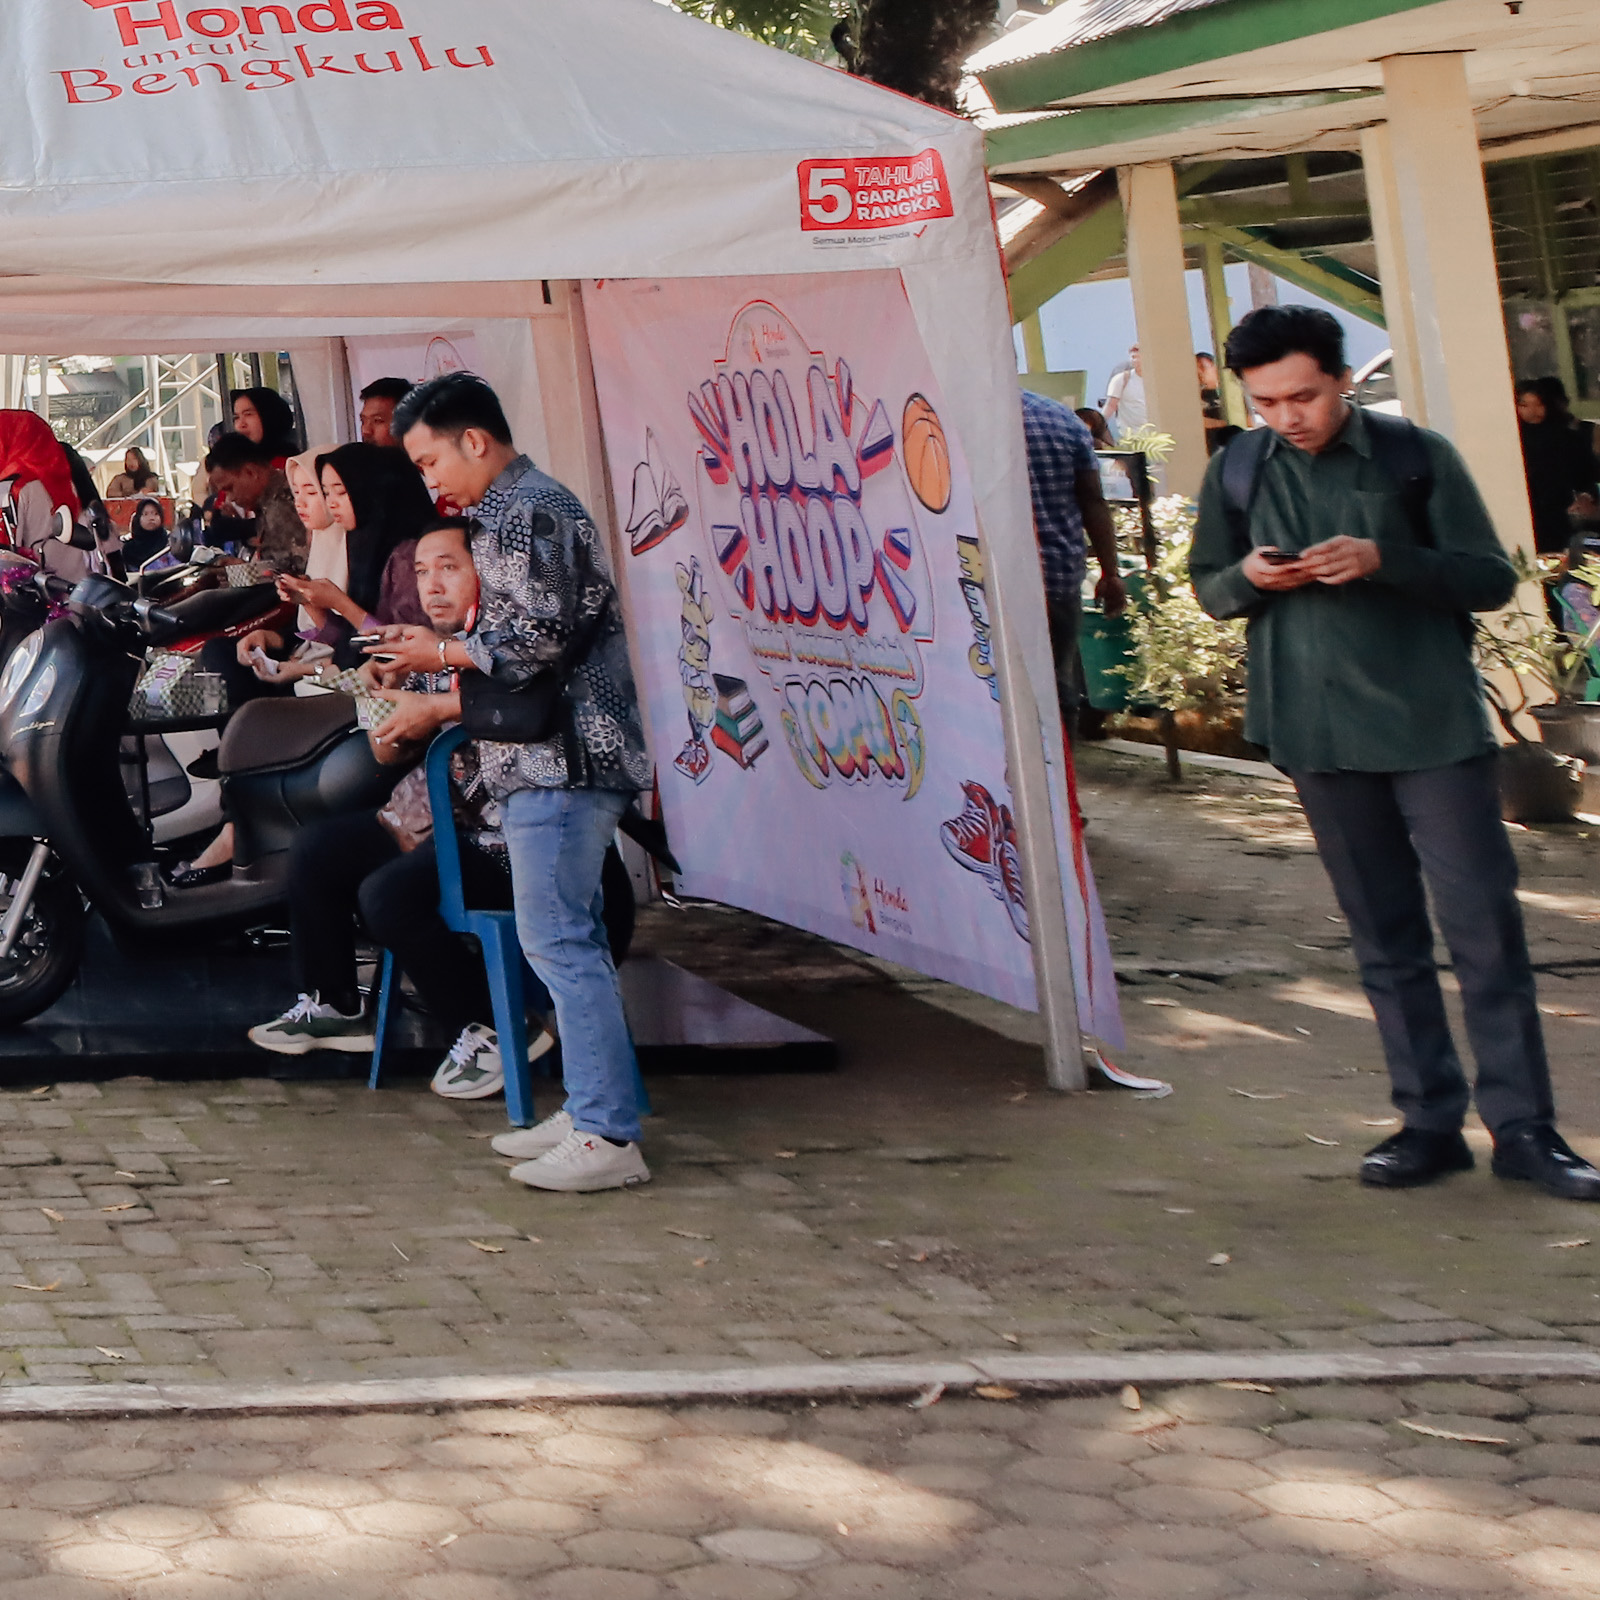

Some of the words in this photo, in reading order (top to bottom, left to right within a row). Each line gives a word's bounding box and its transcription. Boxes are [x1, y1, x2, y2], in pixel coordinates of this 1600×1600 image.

[50, 35, 495, 103] Bengkulu
[123, 29, 269, 68] untuk
[808, 167, 853, 224] 5
[854, 157, 934, 187] TAHUN
[855, 178, 941, 204] GARANSI
[856, 195, 941, 221] RANGKA
[717, 364, 862, 506] HOLA
[740, 492, 876, 634] HOOP
